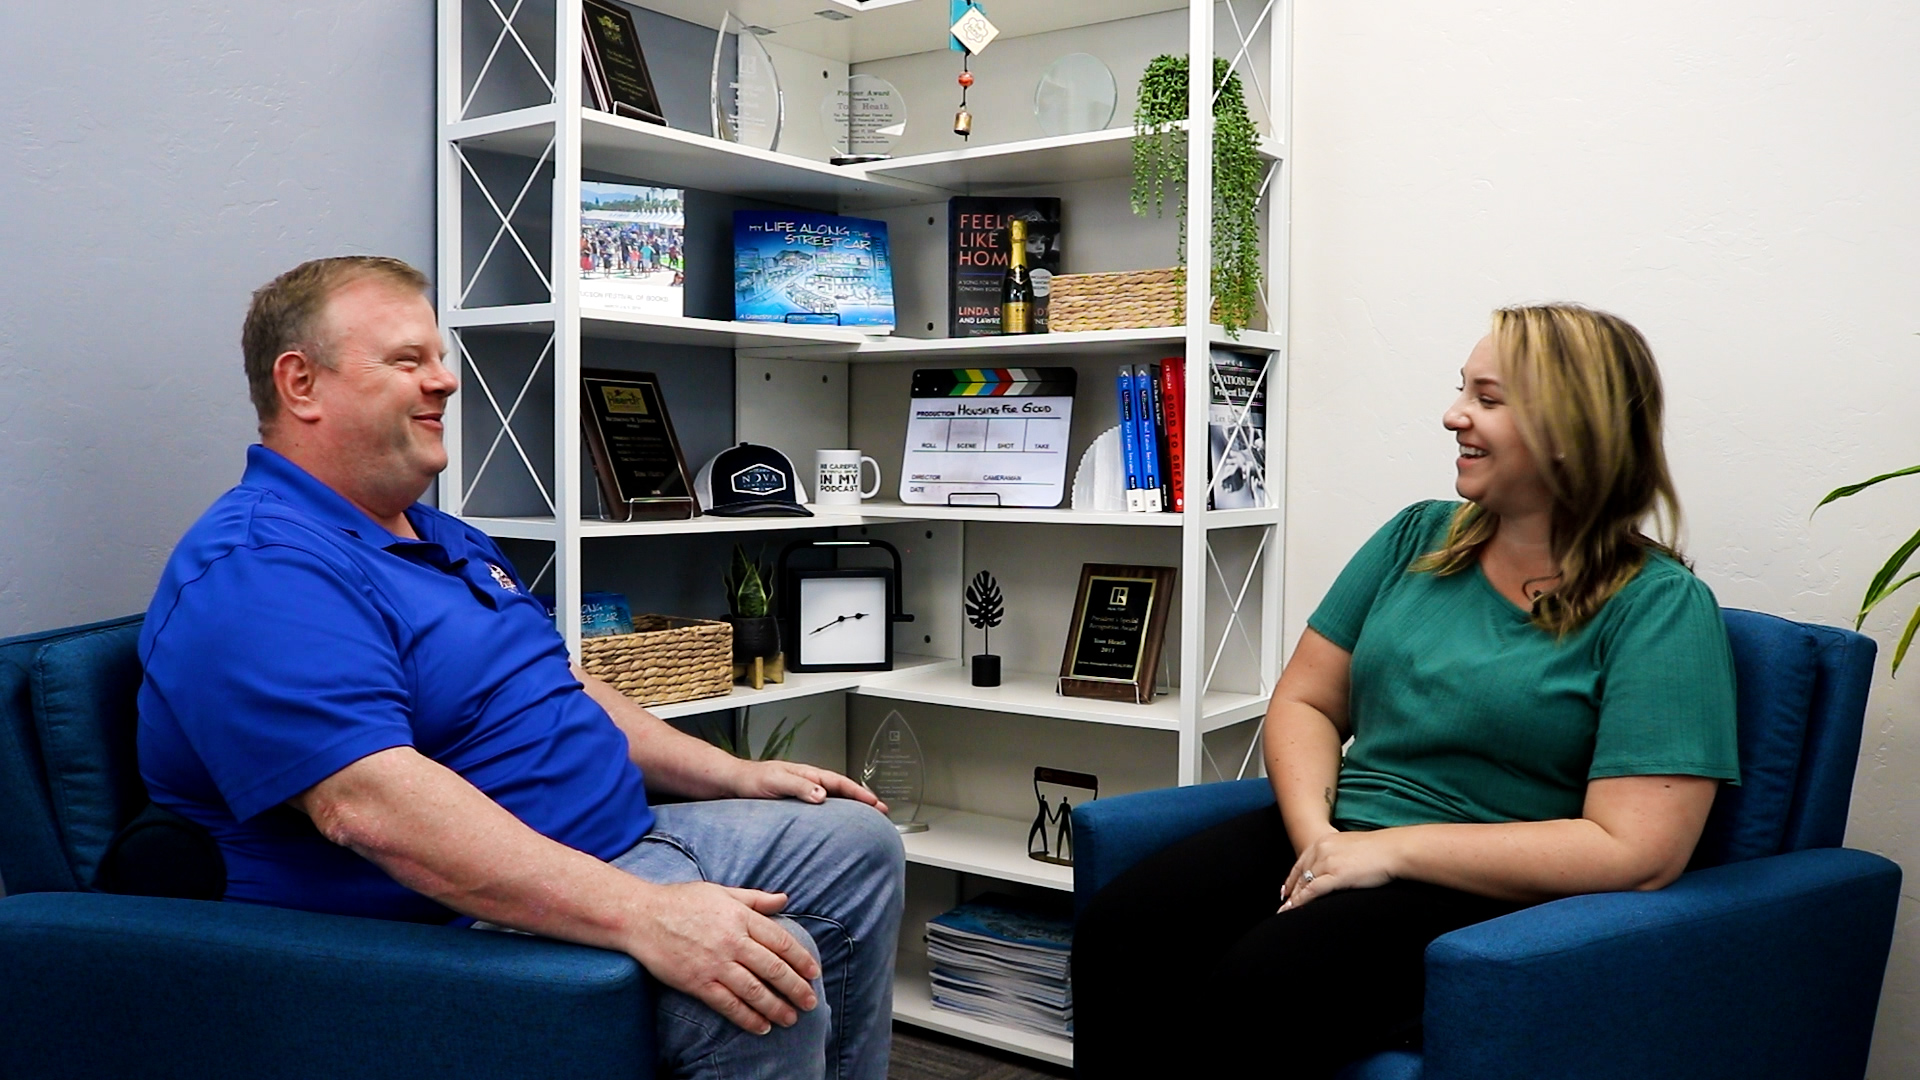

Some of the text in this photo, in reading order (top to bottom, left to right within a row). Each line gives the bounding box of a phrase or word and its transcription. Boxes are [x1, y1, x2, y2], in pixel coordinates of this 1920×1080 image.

[837, 102, 889, 110] Tom Heath
[960, 214, 1015, 230] FEELS
[764, 221, 797, 233] LIFE
[799, 223, 850, 237] ALONG
[851, 230, 871, 238] THE
[784, 234, 871, 251] STREETCAR
[960, 232, 999, 248] LIKE
[959, 250, 1009, 266] HOM
[605, 292, 634, 300] FESTIVAL
[646, 295, 669, 303] BOOKS
[959, 306, 990, 316] LINDA
[1022, 402, 1052, 414] GOOD
[1167, 393, 1183, 494] GOOD TO GREAT
[741, 473, 777, 483] NOVA
[820, 474, 858, 485] IN MY
[820, 485, 858, 493] PODCAST
[581, 603, 603, 613] ONG
[581, 613, 619, 624] EETCAR
